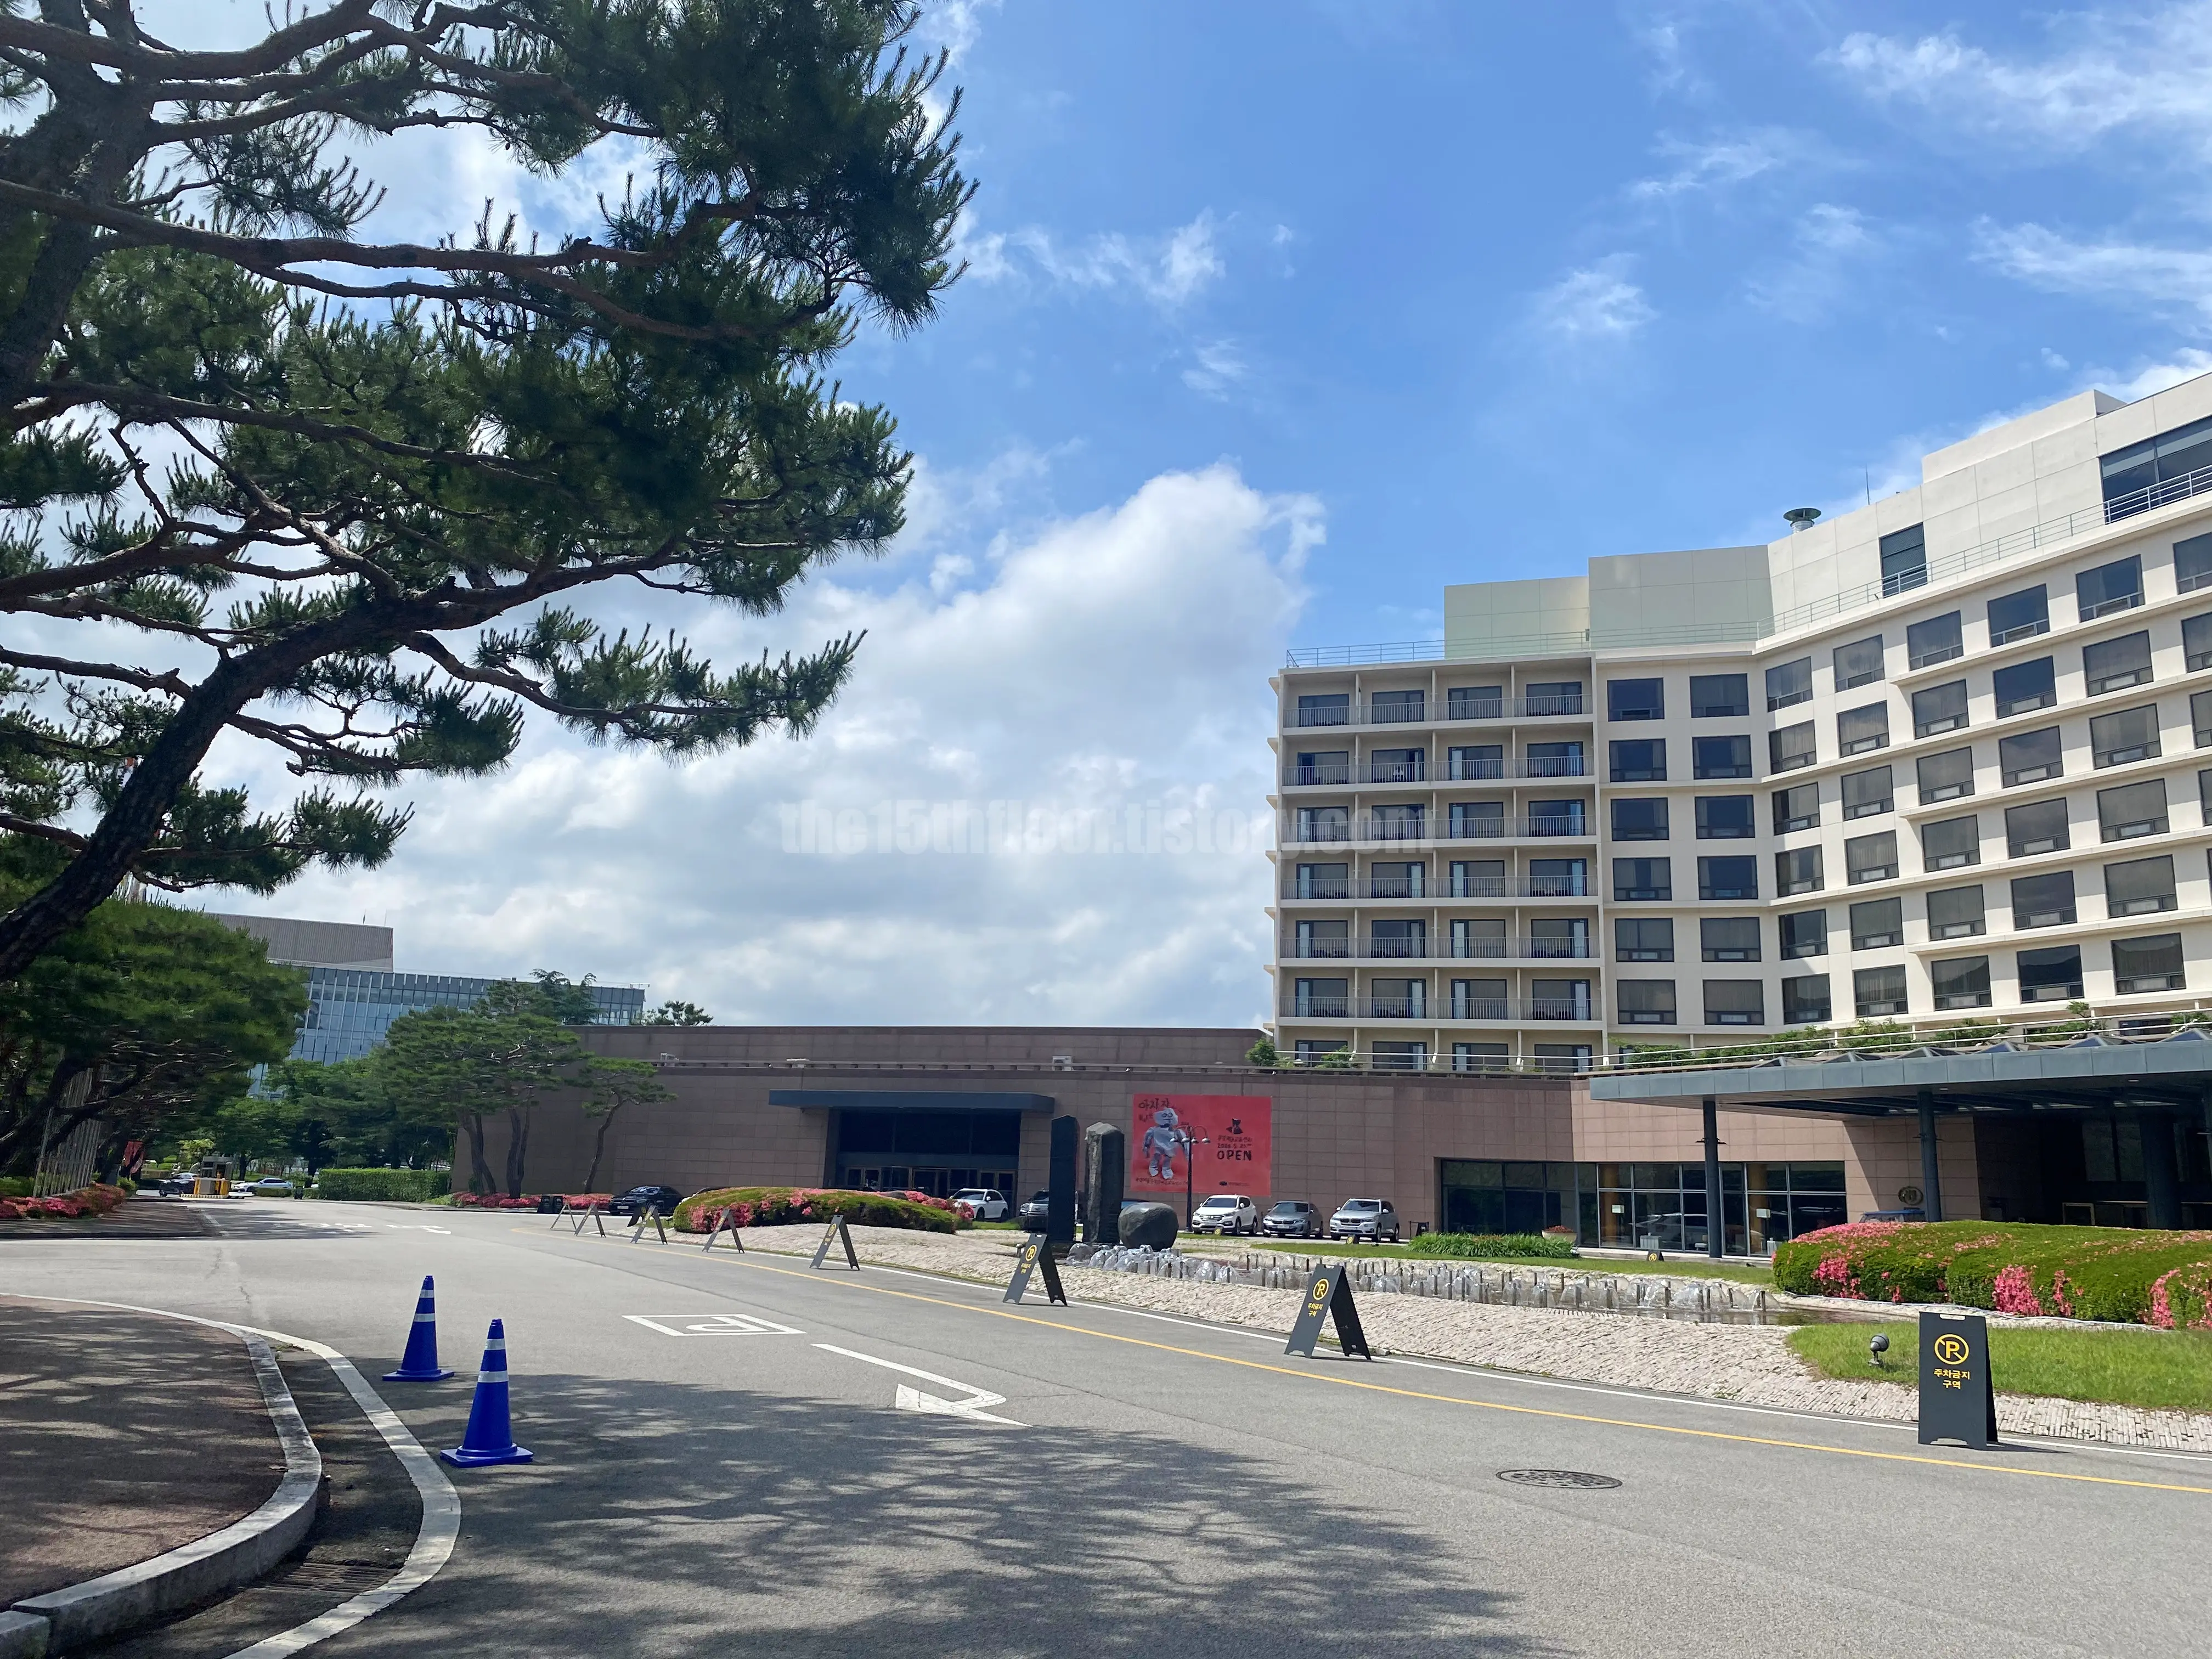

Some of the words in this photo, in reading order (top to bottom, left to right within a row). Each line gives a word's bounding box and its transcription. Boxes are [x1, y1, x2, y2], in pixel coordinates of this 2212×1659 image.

[1217, 1150, 1252, 1161] OPEN
[1933, 1368, 1971, 1380] 주차금지
[1943, 1380, 1961, 1390] 구역
